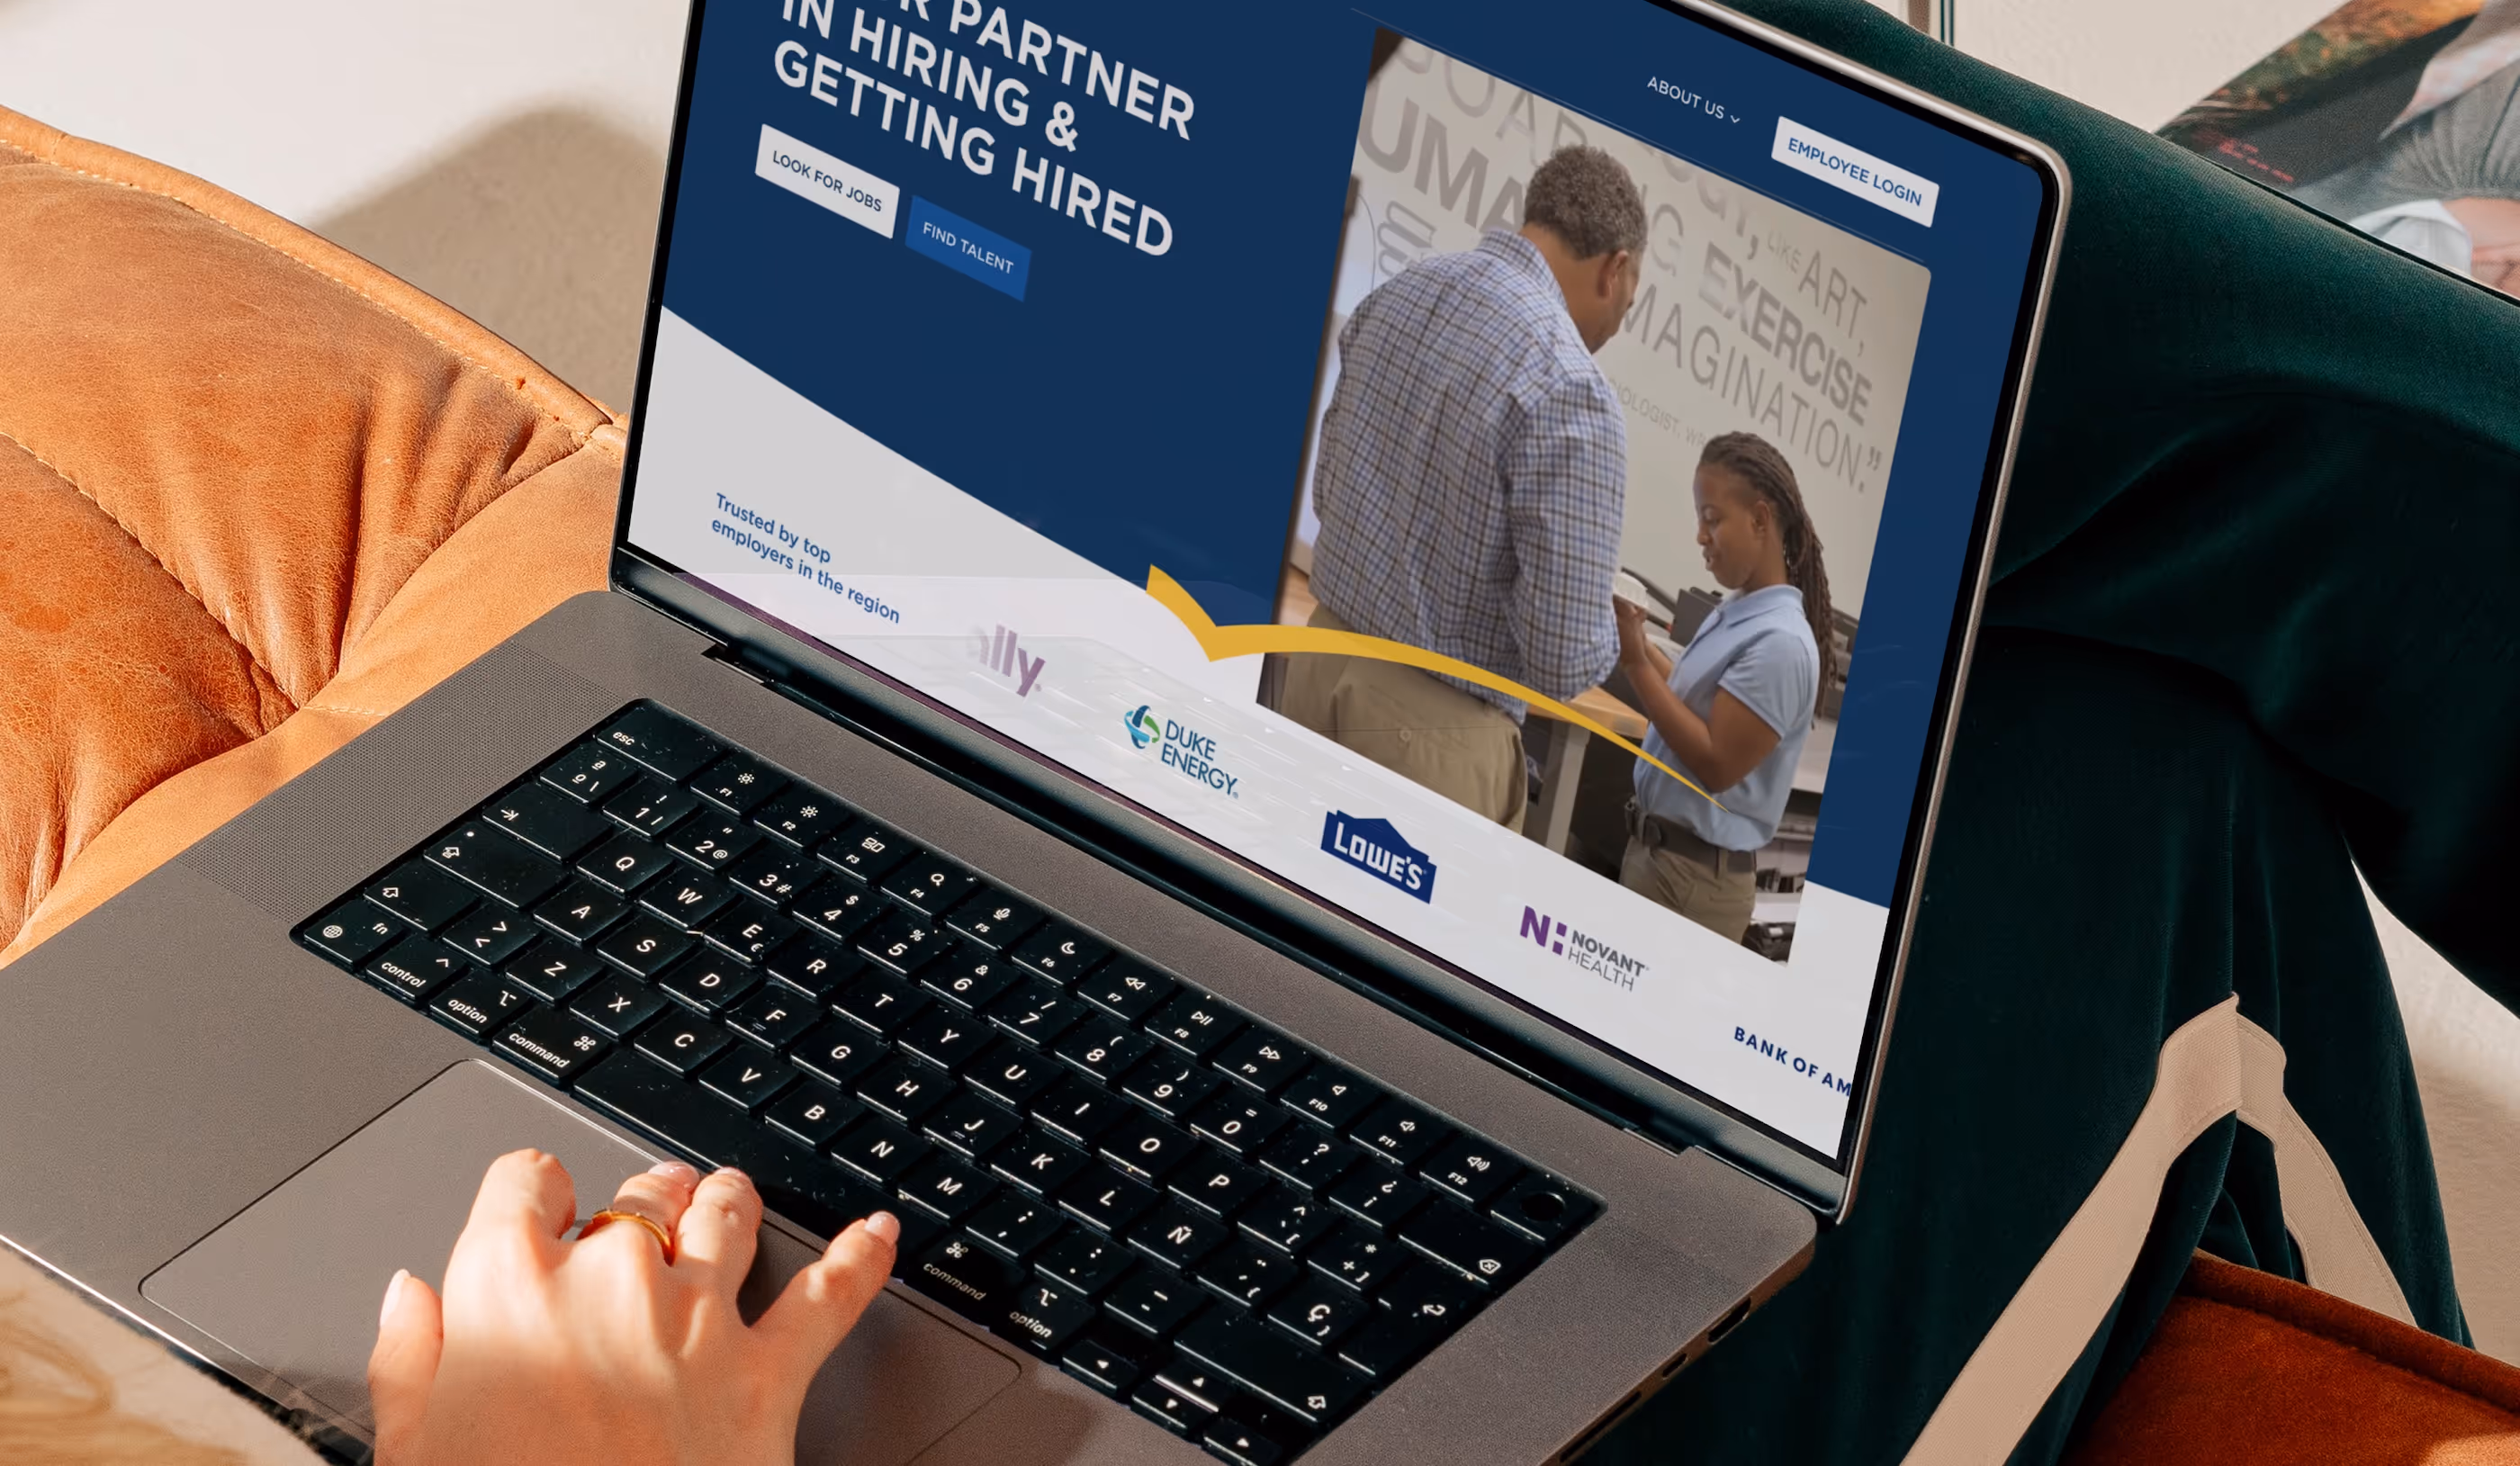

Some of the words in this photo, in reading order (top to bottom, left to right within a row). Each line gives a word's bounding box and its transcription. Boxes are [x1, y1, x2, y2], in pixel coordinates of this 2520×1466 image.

[949, 0, 1195, 140] PARTNER
[850, 7, 1030, 126] HIRING
[1045, 102, 1078, 152] &
[1647, 76, 1702, 109] ABOUT
[1705, 101, 1724, 119] US
[774, 40, 994, 175] GETTING
[1012, 148, 1173, 256] HIRED
[1787, 138, 1869, 184] EMPLOYEE
[1873, 175, 1922, 207] LOGIN
[772, 150, 811, 179] LOOK
[814, 169, 843, 194] FOR
[846, 184, 882, 212] JOBS
[922, 221, 957, 248] FIND
[960, 238, 1014, 274] TALENT
[1767, 229, 1803, 274] LIKE
[1697, 241, 1873, 427] EXERCISE
[716, 492, 774, 535] Trusted
[778, 525, 799, 549] by
[804, 537, 831, 564] top
[712, 518, 793, 571] employers
[798, 560, 813, 580] in
[817, 571, 843, 594] the
[848, 588, 900, 625] region
[612, 730, 635, 747] esc
[1166, 718, 1216, 762] DUKE
[1161, 742, 1238, 797] ENERGY
[695, 839, 715, 854] 2
[616, 857, 634, 871] Q
[759, 873, 778, 887] 3
[678, 888, 702, 904] W
[911, 888, 924, 898] F4
[572, 906, 590, 919] A
[824, 910, 842, 921] 4
[373, 923, 388, 934] fn
[742, 924, 762, 938] E
[636, 940, 656, 952] S
[888, 943, 907, 956] 5
[1571, 930, 1646, 977] NOVANT
[381, 960, 427, 988] control
[544, 962, 566, 976] Z
[806, 959, 826, 974] R
[1568, 949, 1634, 992] HEALTH
[700, 974, 720, 986] D
[954, 978, 972, 990] 6
[608, 997, 631, 1012] X
[876, 994, 893, 1006] T
[448, 997, 488, 1024] option
[766, 1010, 787, 1021] F
[1020, 1012, 1040, 1023] 7
[675, 1034, 694, 1047] C
[941, 1030, 959, 1042] Y
[508, 1031, 571, 1069] command
[832, 1046, 850, 1058] G
[1087, 1048, 1105, 1061] 8
[1734, 1026, 1788, 1065] BANK
[1793, 1057, 1818, 1078] OF
[742, 1068, 760, 1082] V
[1005, 1065, 1026, 1079] U
[896, 1081, 919, 1096] H
[1155, 1084, 1173, 1097] 9
[805, 1105, 825, 1120] B
[1308, 1098, 1328, 1112] F10
[965, 1120, 984, 1130] J
[871, 1141, 894, 1157] N
[1379, 1136, 1396, 1147] F11
[1031, 1154, 1053, 1169] K
[937, 1178, 962, 1194] M
[1209, 1174, 1229, 1186] P
[1447, 1171, 1469, 1186] F12
[1100, 1191, 1114, 1206] L
[1168, 1227, 1192, 1244] Ñ
[924, 1264, 986, 1300] command
[1308, 1305, 1330, 1322] Ç
[1010, 1312, 1052, 1337] option
